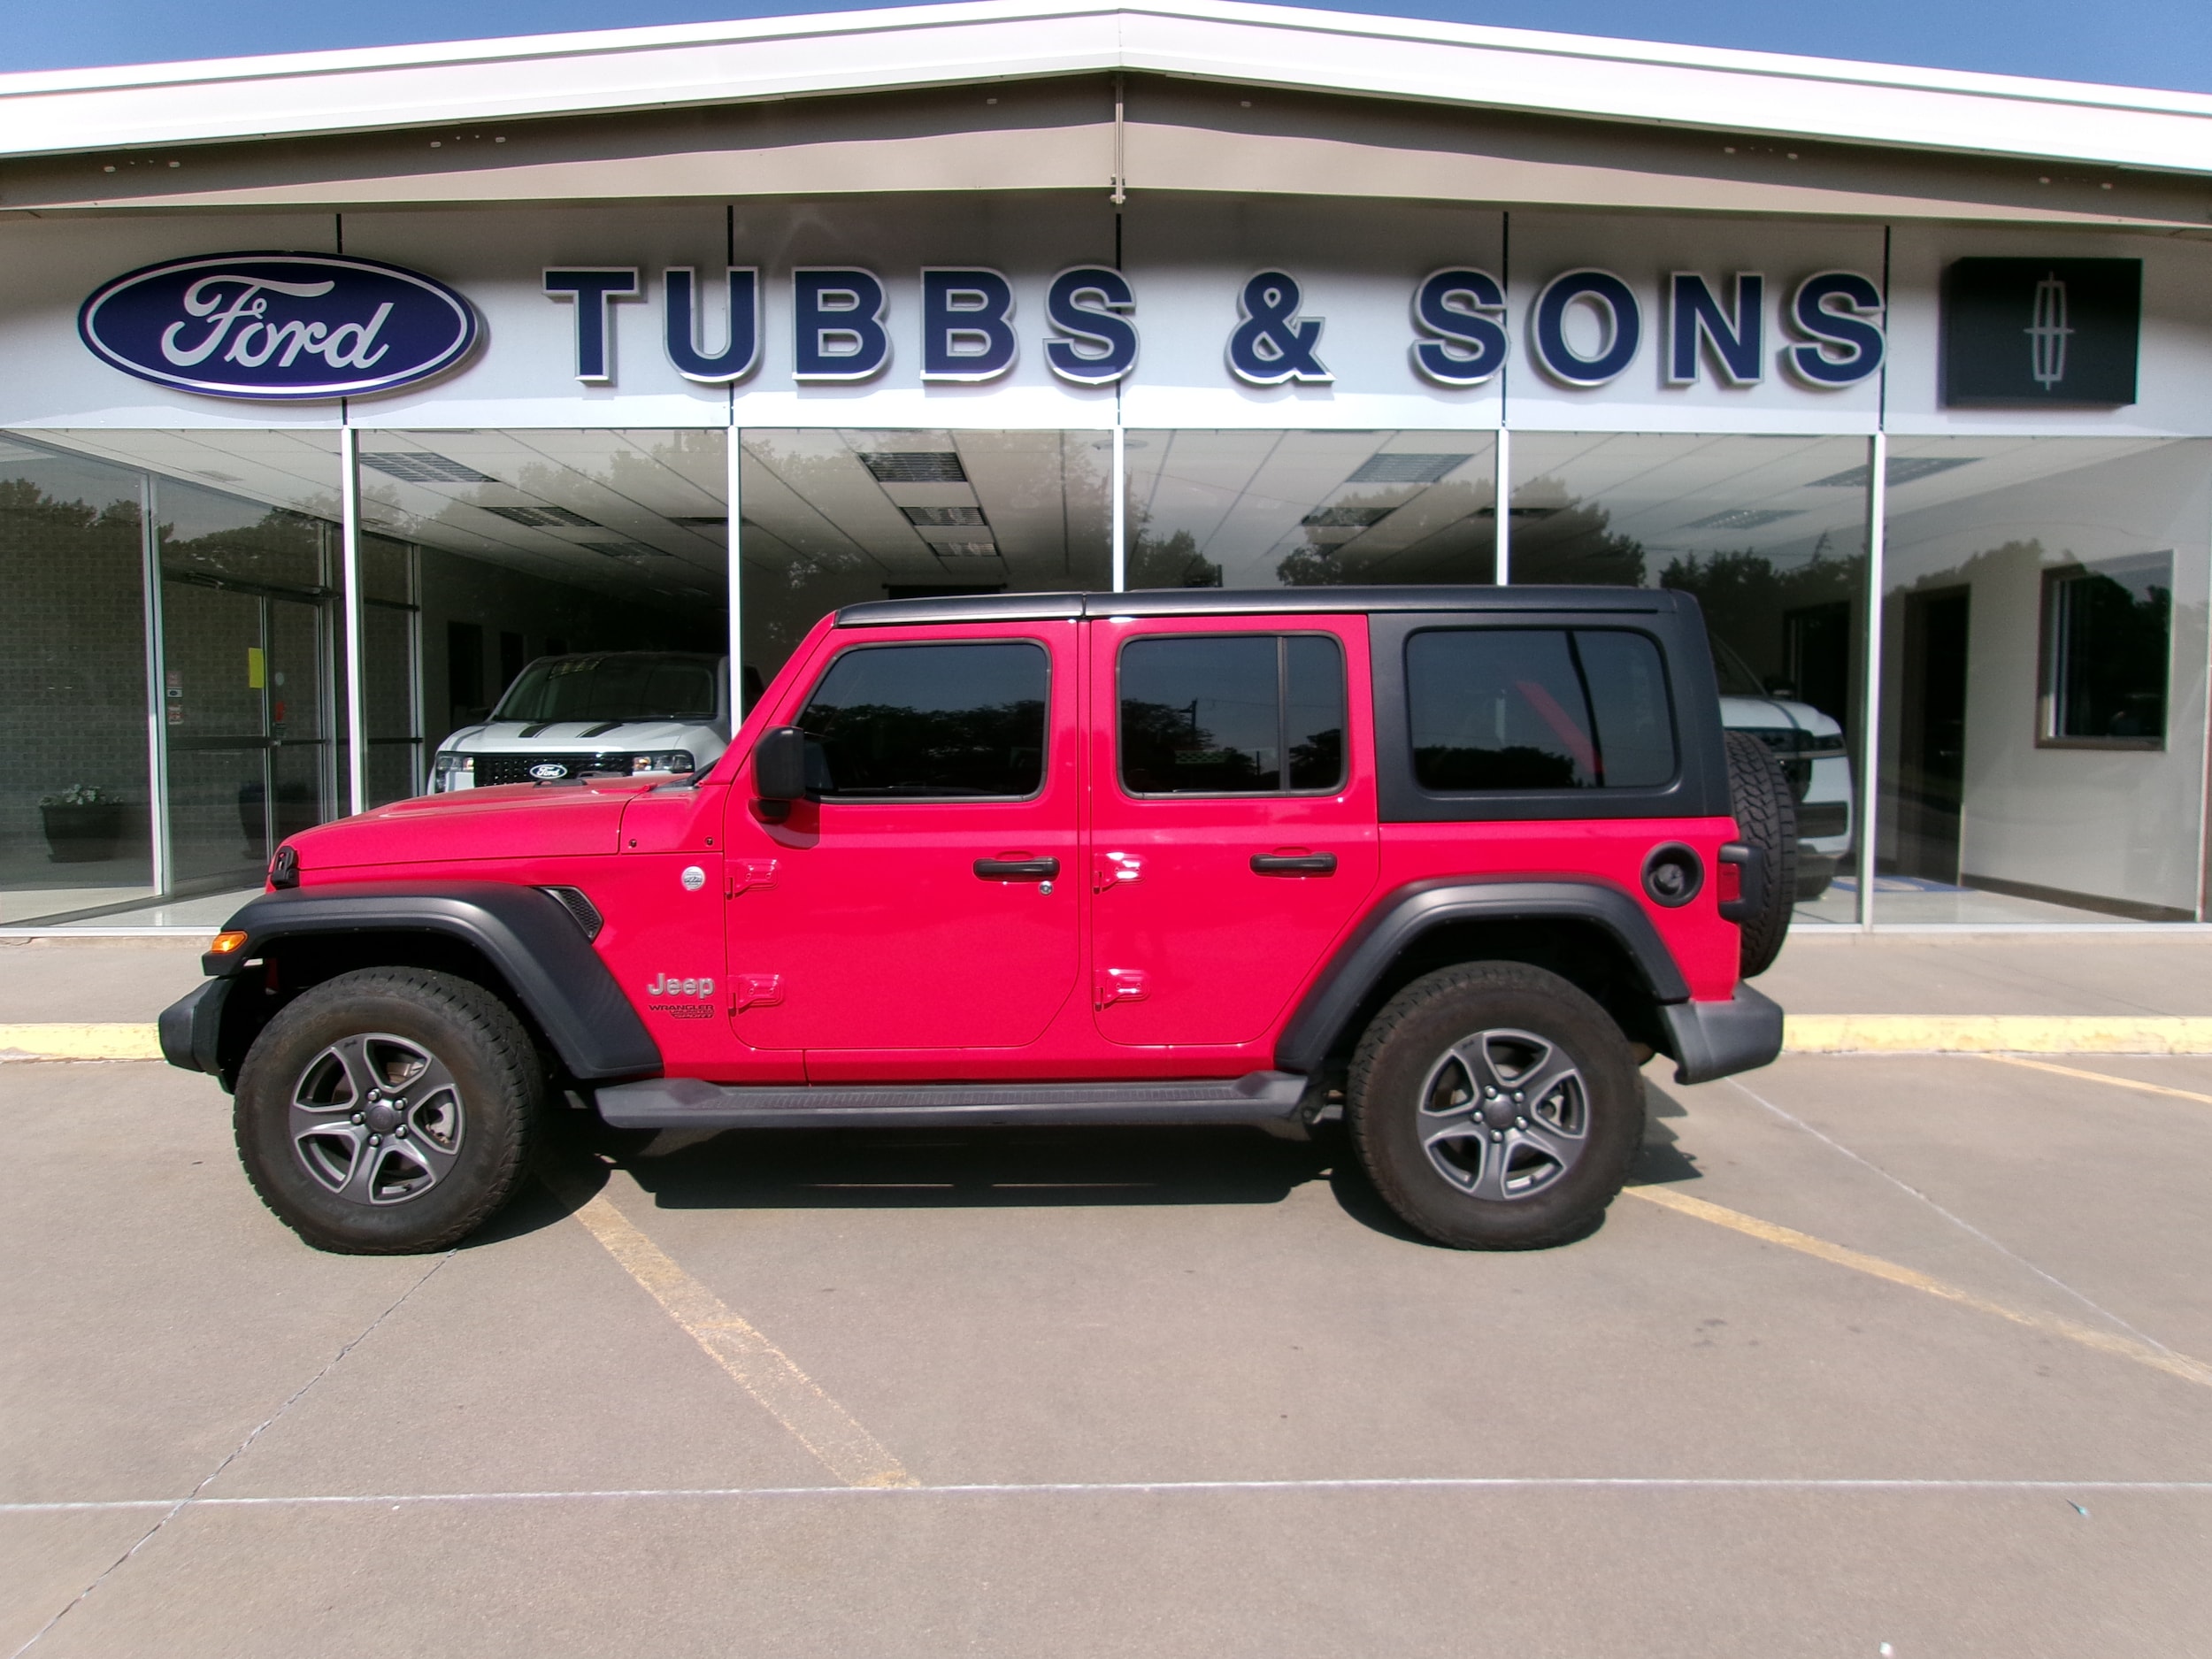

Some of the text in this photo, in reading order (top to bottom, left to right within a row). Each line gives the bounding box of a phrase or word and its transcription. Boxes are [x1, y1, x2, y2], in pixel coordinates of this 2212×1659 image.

[161, 274, 395, 368] Ford
[541, 265, 1887, 388] TUBBS & SONS
[536, 766, 561, 777] Ford
[648, 972, 714, 999] Jeep
